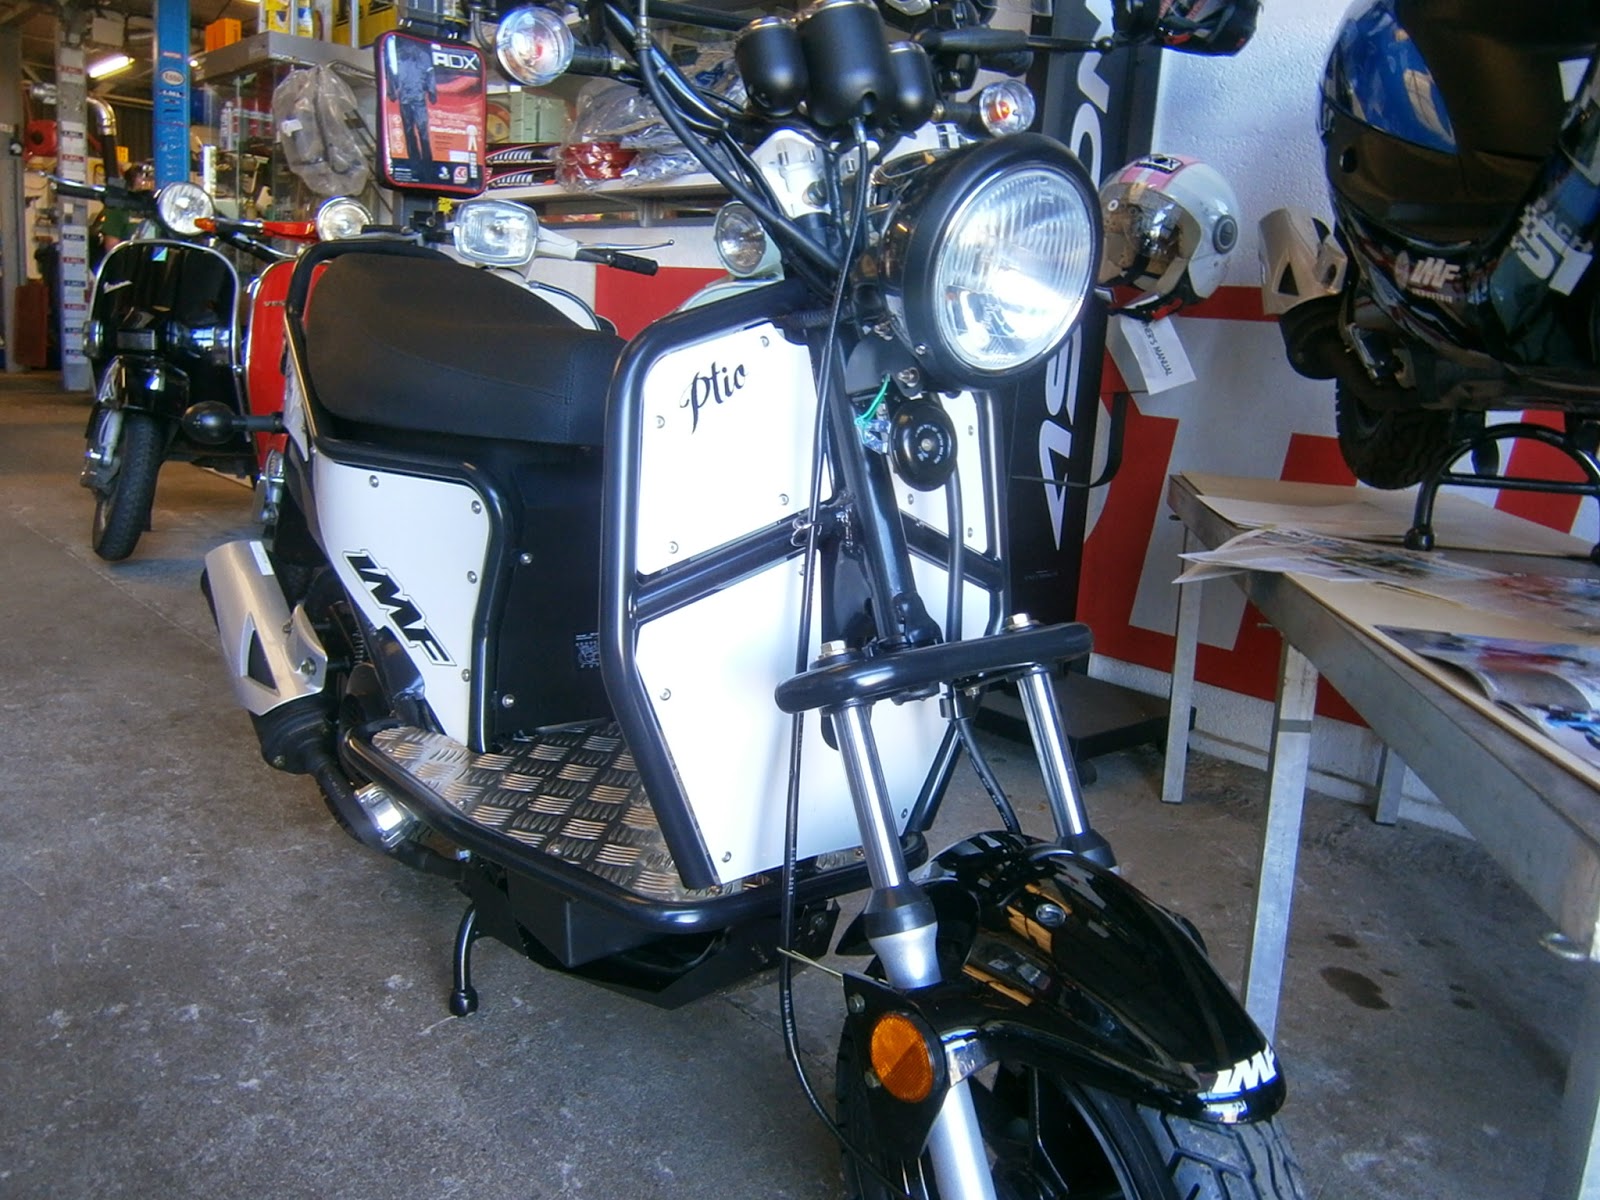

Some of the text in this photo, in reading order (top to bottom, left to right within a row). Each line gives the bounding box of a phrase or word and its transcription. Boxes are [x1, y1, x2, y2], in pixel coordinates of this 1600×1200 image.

[1410, 256, 1461, 289] IMF
[1153, 346, 1173, 377] MANUAL
[344, 552, 454, 665] IMF
